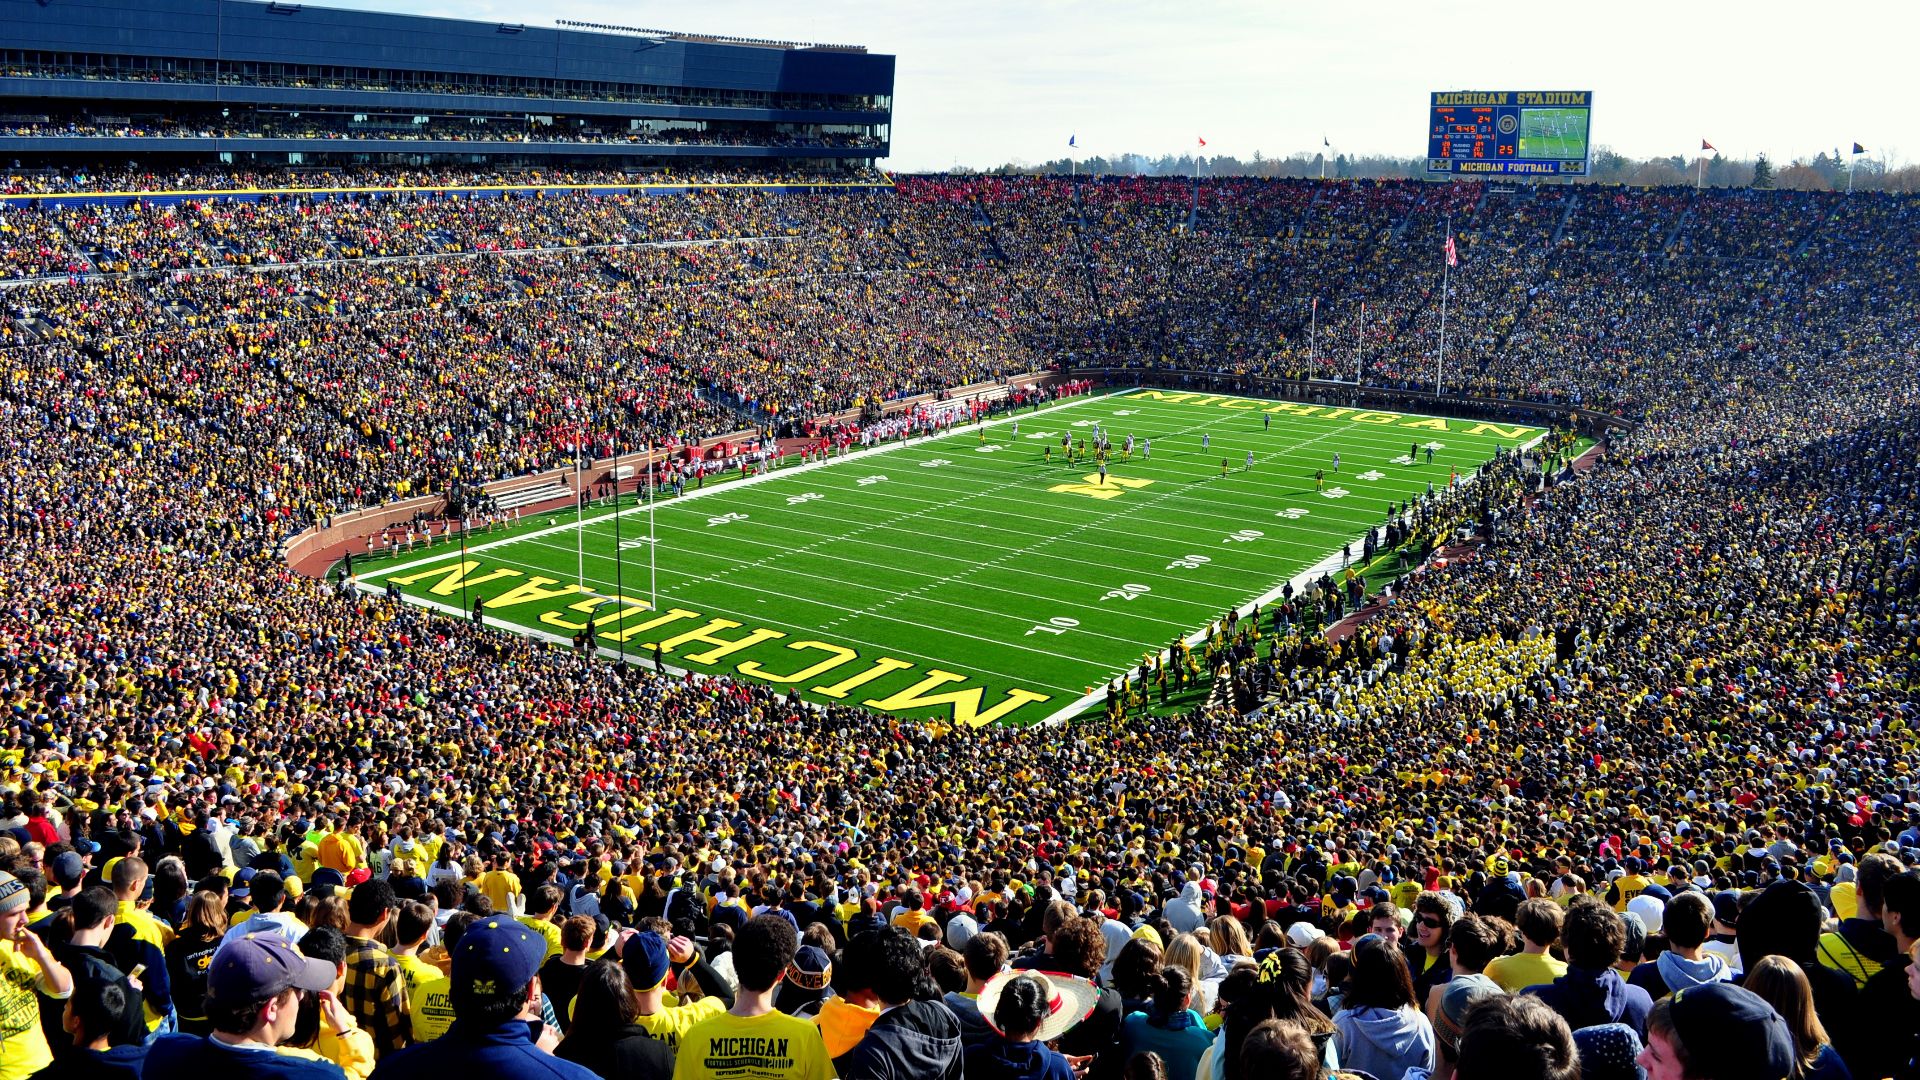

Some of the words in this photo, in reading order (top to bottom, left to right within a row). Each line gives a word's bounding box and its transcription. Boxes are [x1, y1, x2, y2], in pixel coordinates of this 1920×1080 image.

[1436, 93, 1508, 105] MICHIGAN
[1517, 92, 1586, 105] STADIUM
[1477, 115, 1491, 123] 24
[1499, 145, 1514, 154] 25
[1460, 162, 1504, 172] MICHIGAN
[1508, 163, 1555, 173] FOOTBALL
[1131, 391, 1537, 438] MICHIGAN
[856, 474, 889, 488] 40
[786, 492, 825, 506] 30
[707, 512, 749, 527] 20
[616, 534, 662, 551] 10
[1230, 529, 1265, 542] 40
[1169, 554, 1212, 569] 30
[1107, 583, 1152, 601] 20
[1033, 616, 1081, 636] 10
[385, 560, 1053, 729] MICHIGAN
[709, 1037, 788, 1056] MICHIGAN
[707, 1058, 733, 1067] FOOTBALL
[734, 1057, 761, 1066] SCHEDULE
[715, 1068, 746, 1076] SEPTEMBER
